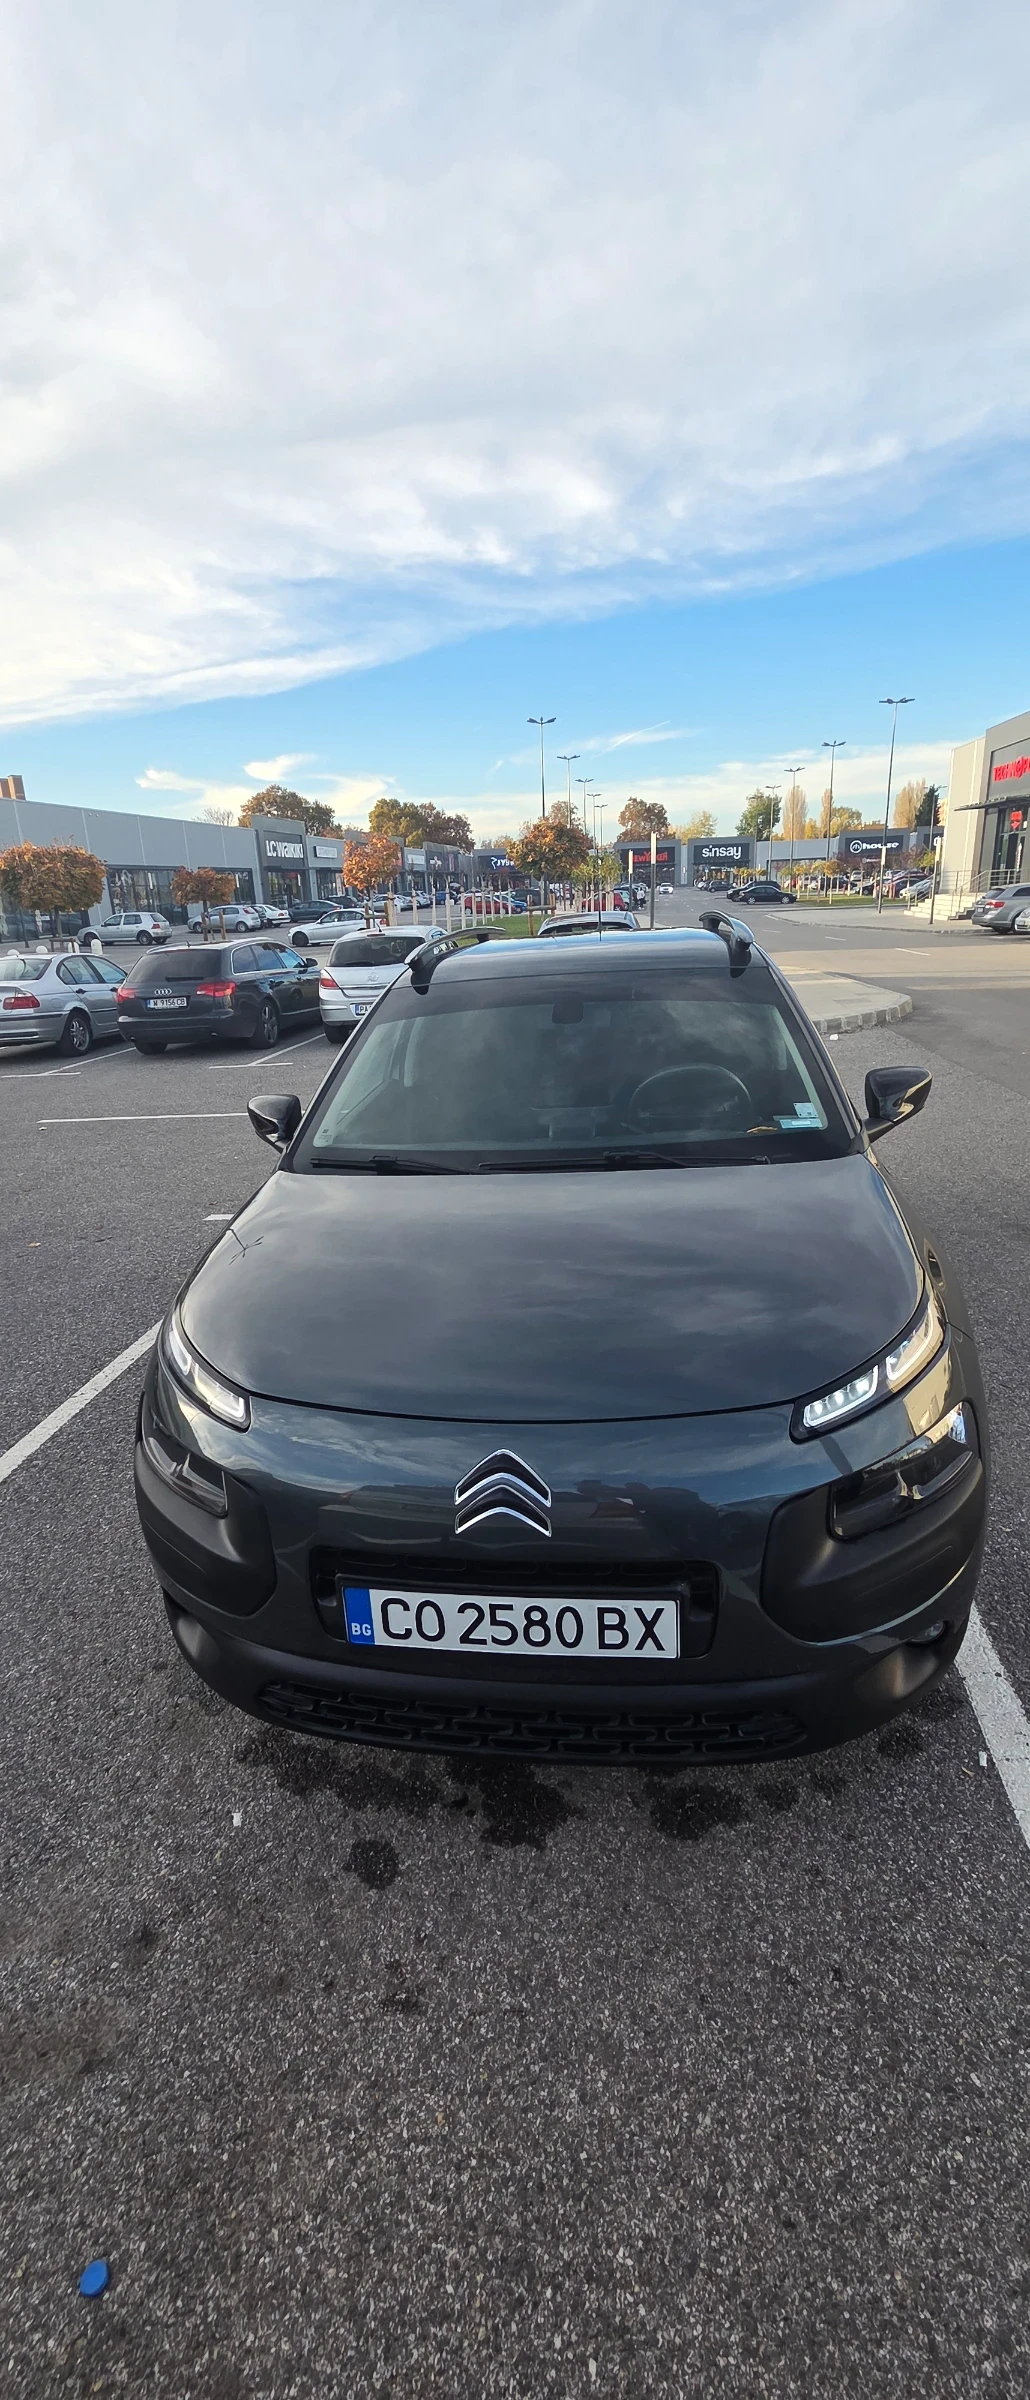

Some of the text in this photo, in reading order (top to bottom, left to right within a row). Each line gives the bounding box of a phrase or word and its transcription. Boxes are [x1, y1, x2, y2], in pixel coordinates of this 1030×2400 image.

[993, 756, 1030, 781] TECHNOP
[702, 845, 741, 859] sinsay
[351, 1597, 665, 1652] BG CO 2580 BX
